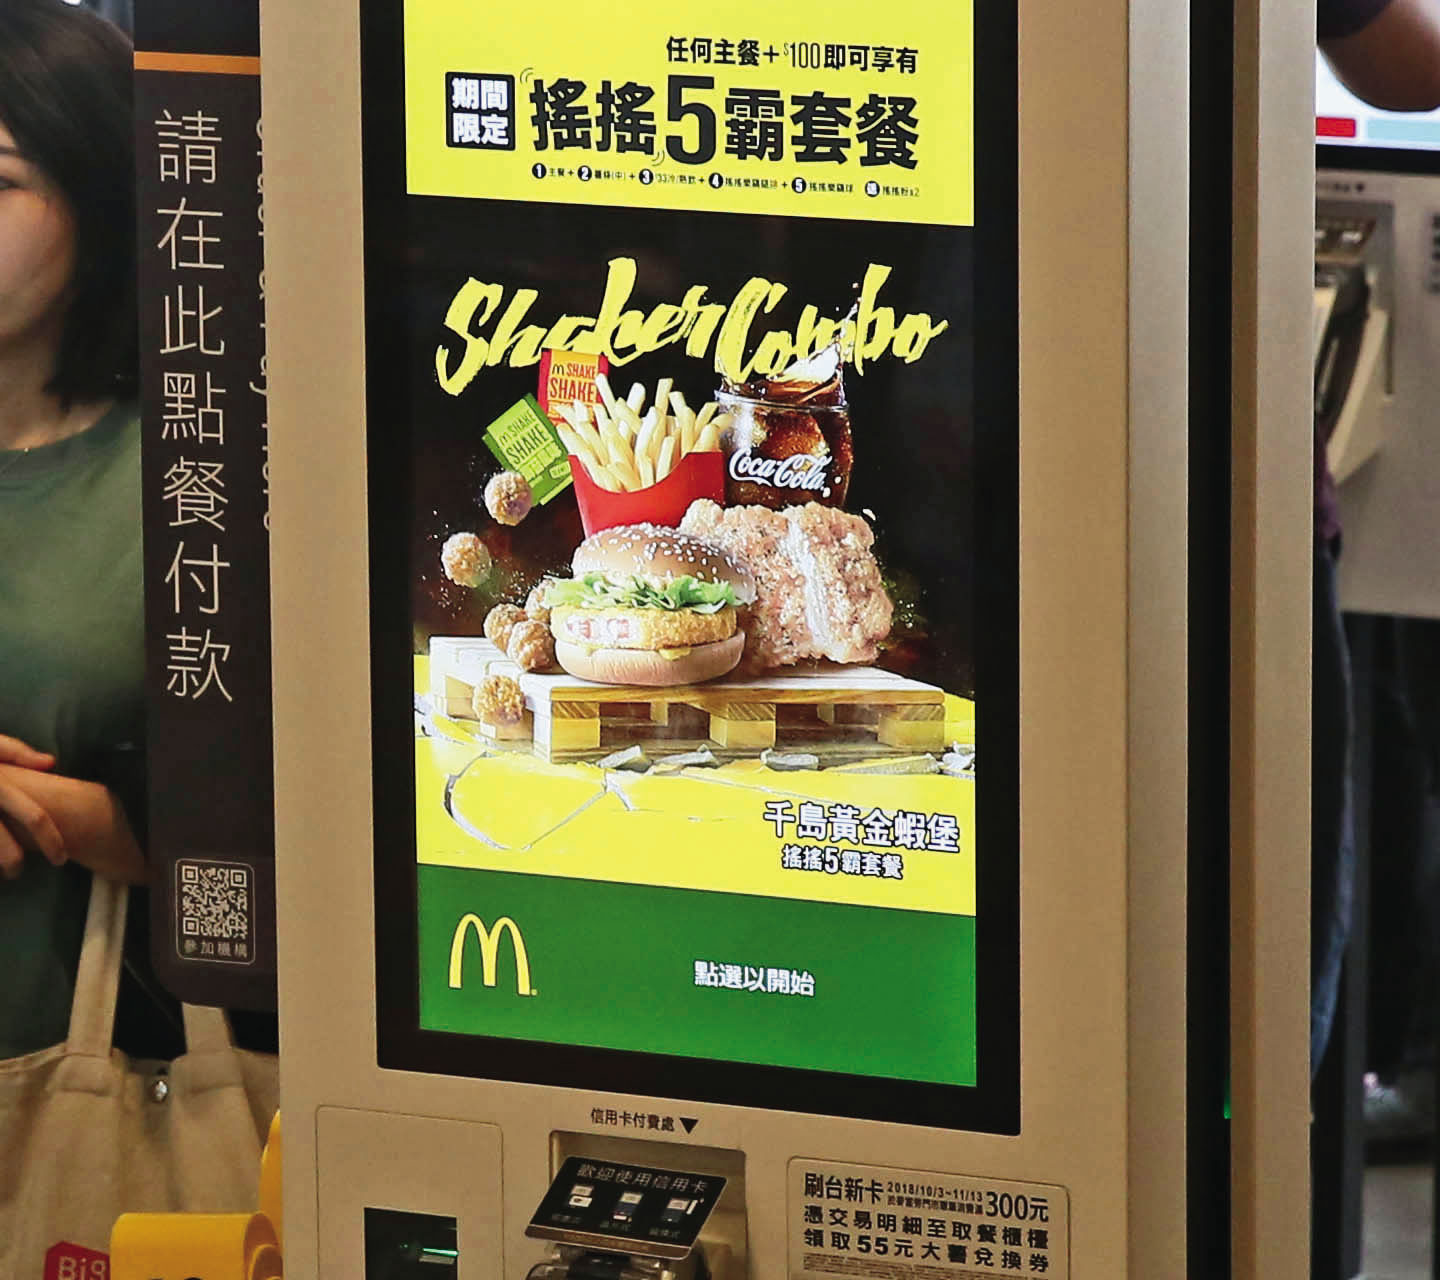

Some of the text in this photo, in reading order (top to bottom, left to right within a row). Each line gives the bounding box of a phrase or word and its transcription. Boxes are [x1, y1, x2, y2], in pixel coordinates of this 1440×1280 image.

[452, 77, 508, 111] 期間
[452, 112, 510, 146] 限定
[528, 74, 920, 170] 搖搖5霸套餐
[436, 257, 948, 396] Shaker Combo
[567, 363, 596, 379] SHAKE
[154, 109, 234, 703] 請在此點餐付款
[508, 410, 536, 437] SHAKE
[506, 424, 551, 464] SHAKE
[729, 447, 832, 491] Coca-Cola
[763, 800, 960, 853] 千島黃金蝦堡
[782, 844, 903, 880] 搖搖5霸套餐
[693, 959, 816, 998] 點選以開始
[590, 1108, 676, 1132] 信用卡付費處
[577, 1163, 709, 1193] 歡迎使用信用卡
[803, 1172, 884, 1205] 刷台新卡
[986, 1191, 1049, 1223] 300元
